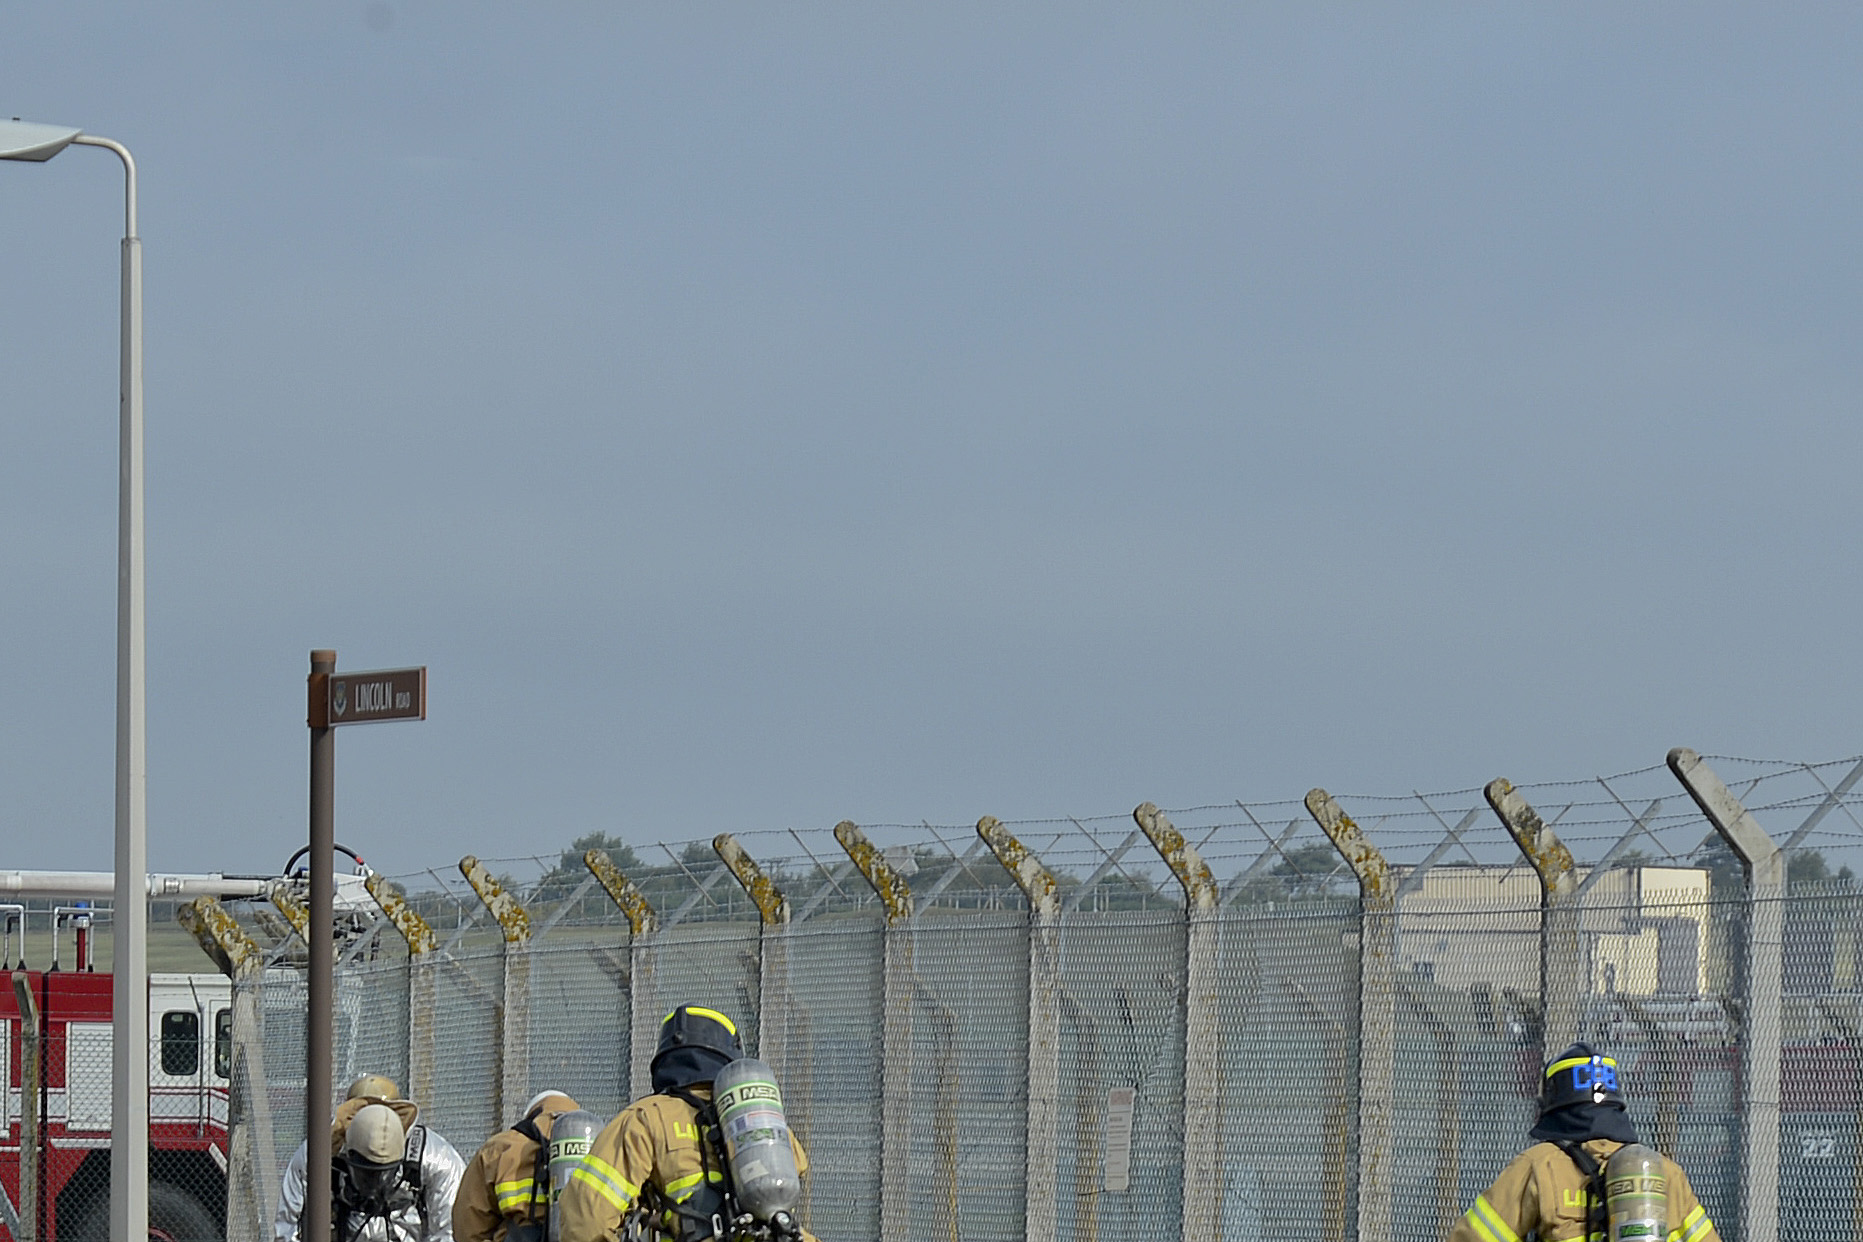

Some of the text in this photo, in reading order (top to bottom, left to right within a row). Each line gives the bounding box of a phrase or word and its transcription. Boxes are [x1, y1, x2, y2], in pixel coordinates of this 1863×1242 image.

[354, 681, 411, 712] LINCOLN ROAD
[565, 1143, 591, 1155] MS
